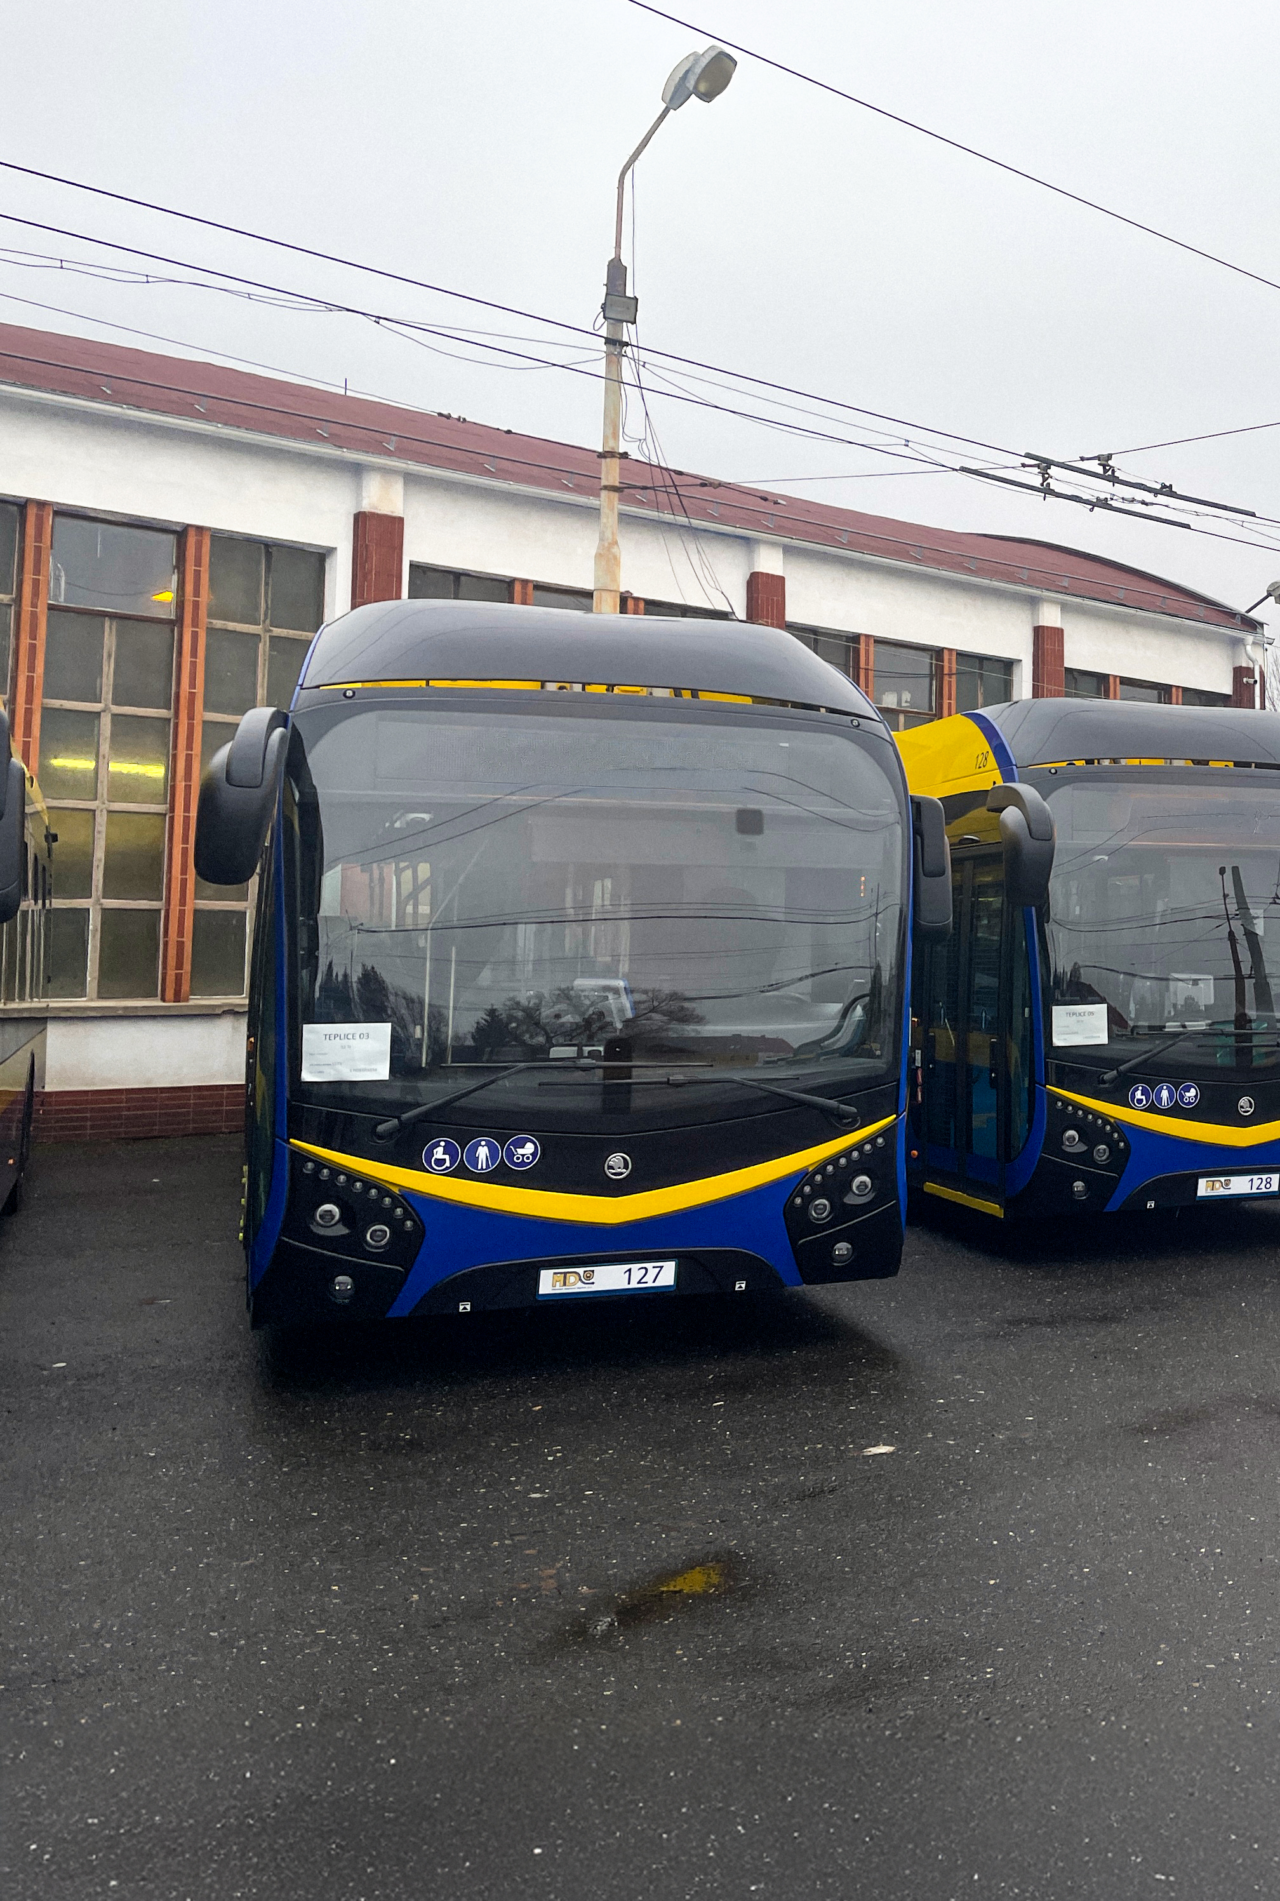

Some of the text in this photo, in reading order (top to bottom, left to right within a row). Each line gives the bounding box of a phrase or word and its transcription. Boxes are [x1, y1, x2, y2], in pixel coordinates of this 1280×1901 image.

[975, 750, 989, 769] 128
[323, 1032, 370, 1041] TEPLICE 03
[1248, 1176, 1273, 1191] 128
[623, 1265, 665, 1285] 127
